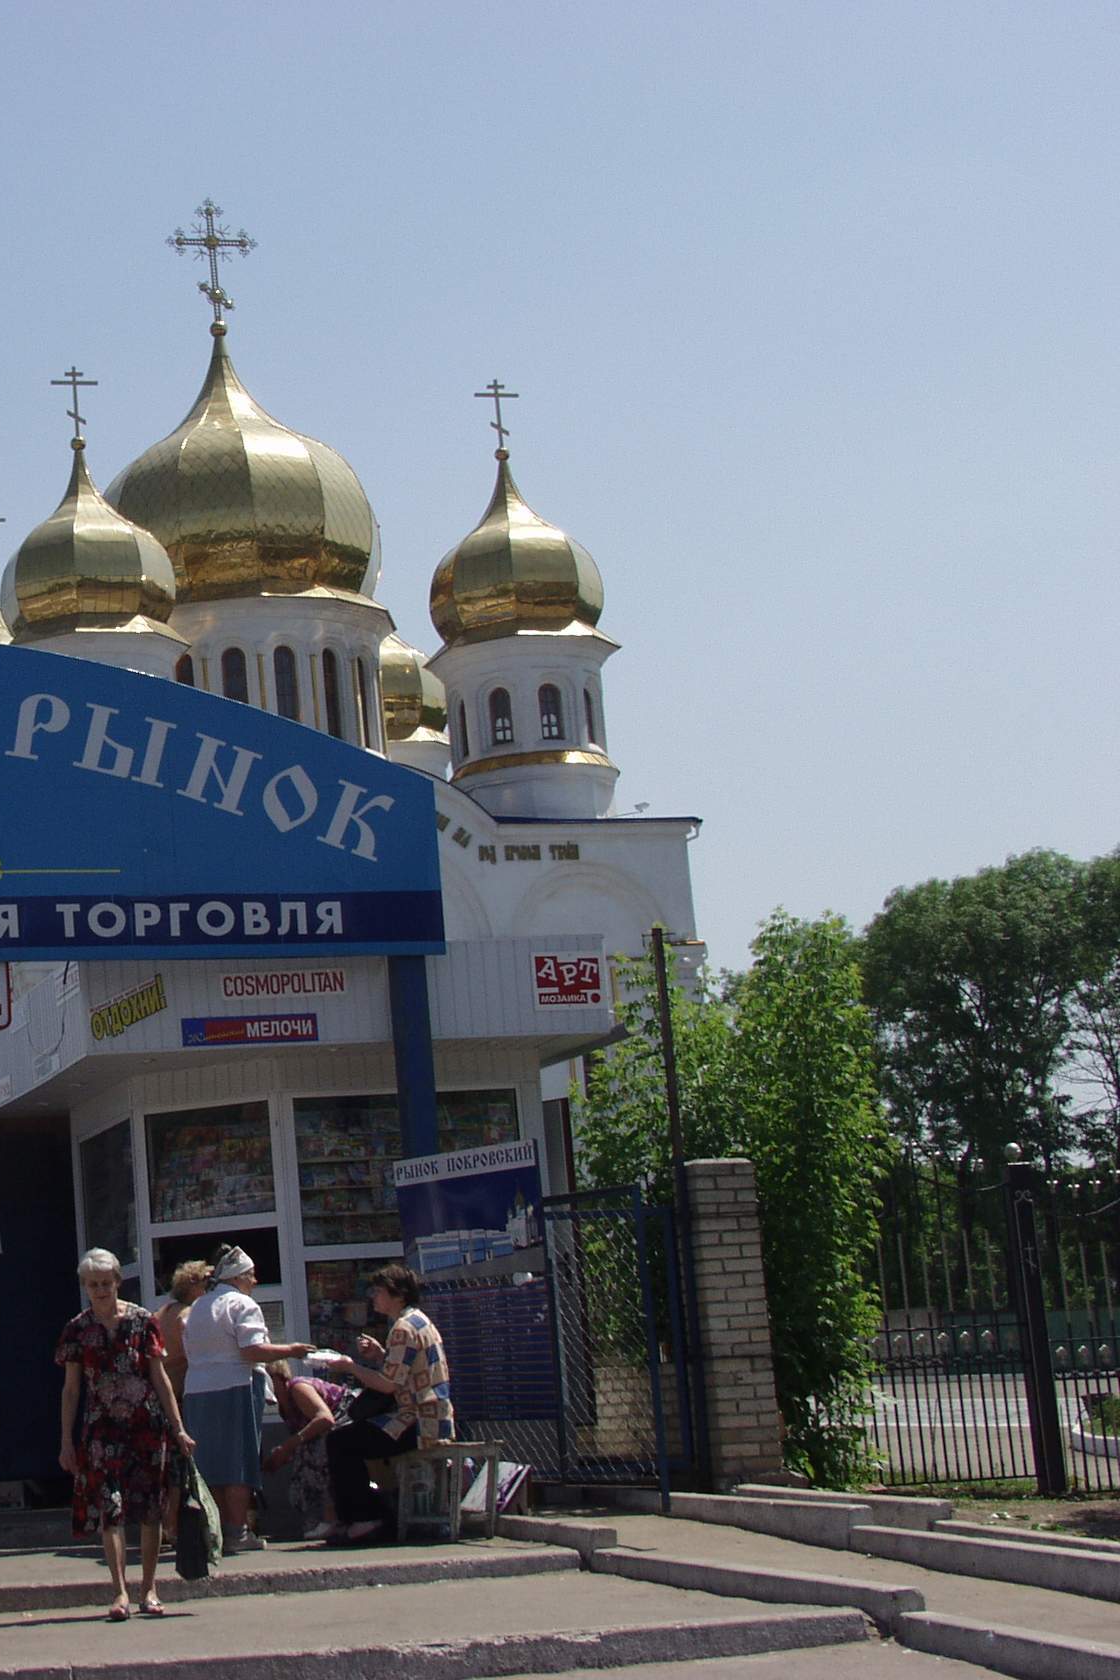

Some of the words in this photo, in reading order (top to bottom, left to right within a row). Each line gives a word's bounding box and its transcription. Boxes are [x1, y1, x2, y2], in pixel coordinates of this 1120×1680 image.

[4, 693, 396, 862] РЫНОК
[55, 899, 344, 938] ТОРГОВЛЯ
[222, 970, 345, 998] COSMOPOLITAN
[537, 957, 598, 986] АРТ
[90, 973, 168, 1041] ОТДОХНИ!
[246, 1019, 313, 1038] МЕЛОЧИ
[396, 1159, 438, 1180] РЫНОК
[447, 1142, 533, 1172] ПОКРОВСКИЙ
